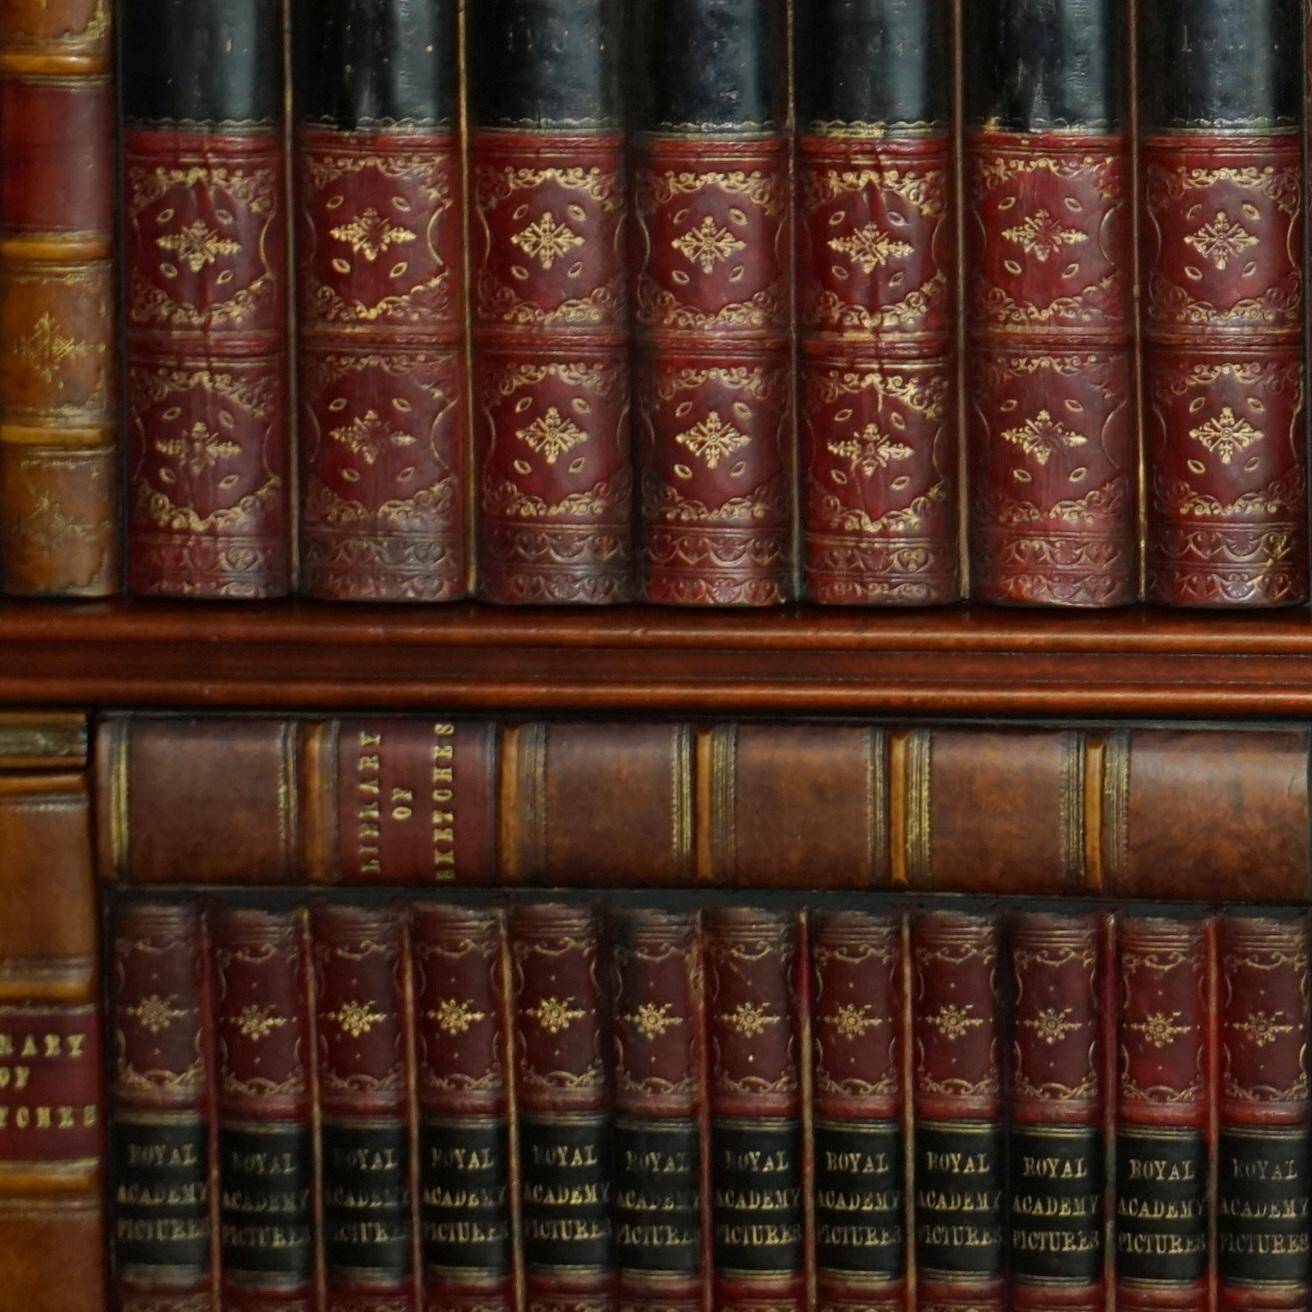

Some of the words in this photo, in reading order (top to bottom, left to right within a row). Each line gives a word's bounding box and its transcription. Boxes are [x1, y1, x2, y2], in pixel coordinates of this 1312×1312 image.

[358, 730, 381, 874] LIBRARY
[390, 787, 413, 821] OF
[432, 723, 456, 881] SKETCHES
[128, 1142, 198, 1167] ROYAL
[333, 1147, 398, 1172] OYAL
[626, 1150, 690, 1174] ROYAL
[825, 1150, 890, 1174] ROYAL
[926, 1150, 991, 1174] ROYAL
[1023, 1156, 1088, 1179] ROYAL
[1129, 1158, 1195, 1182] ROYAL
[1232, 1157, 1298, 1181] ROYAL
[1012, 1193, 1099, 1217] ACADEMY
[1221, 1195, 1309, 1219] ACADEMY
